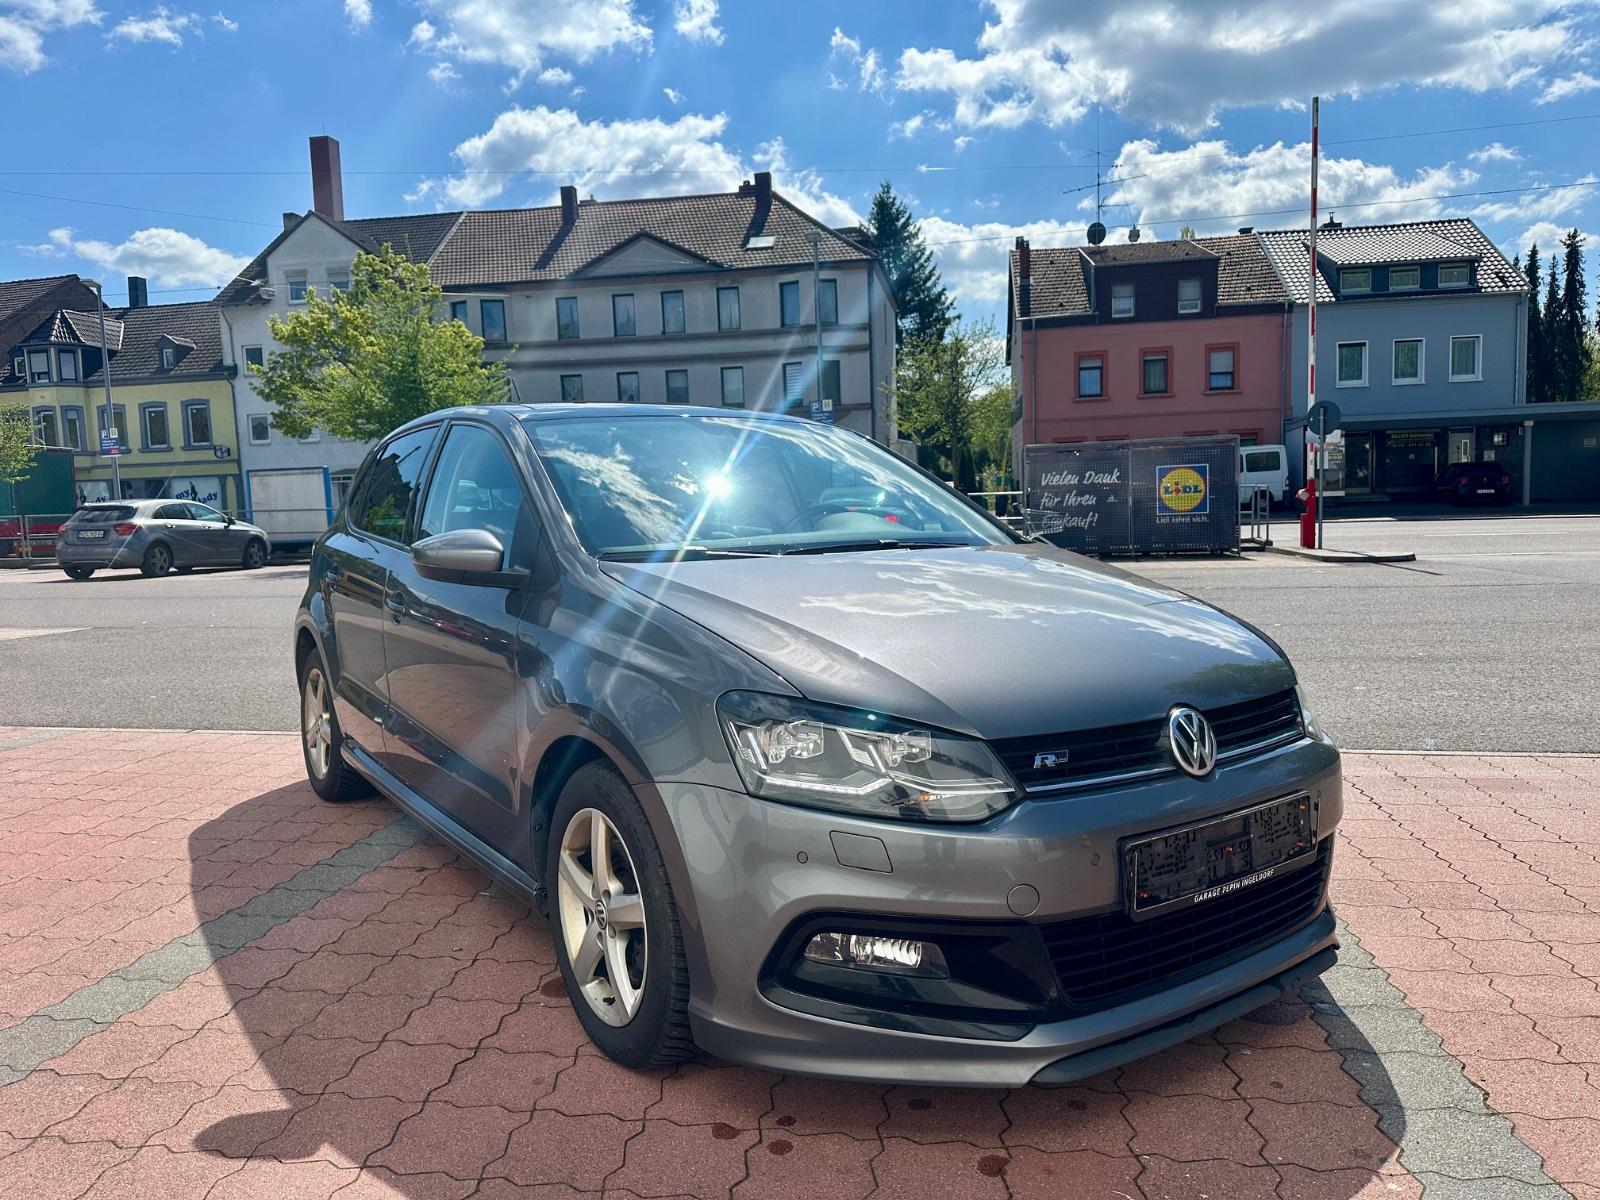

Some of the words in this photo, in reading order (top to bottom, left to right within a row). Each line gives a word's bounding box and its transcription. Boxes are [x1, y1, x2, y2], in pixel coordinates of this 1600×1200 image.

[1041, 470, 1080, 486] Vielen
[1083, 468, 1120, 485] Dank
[1041, 492, 1061, 509] für
[1063, 490, 1097, 507] Ihren
[1194, 887, 1221, 903] GARAGE
[1222, 881, 1240, 894] PEPIN
[1241, 868, 1275, 887] INGELDORF
